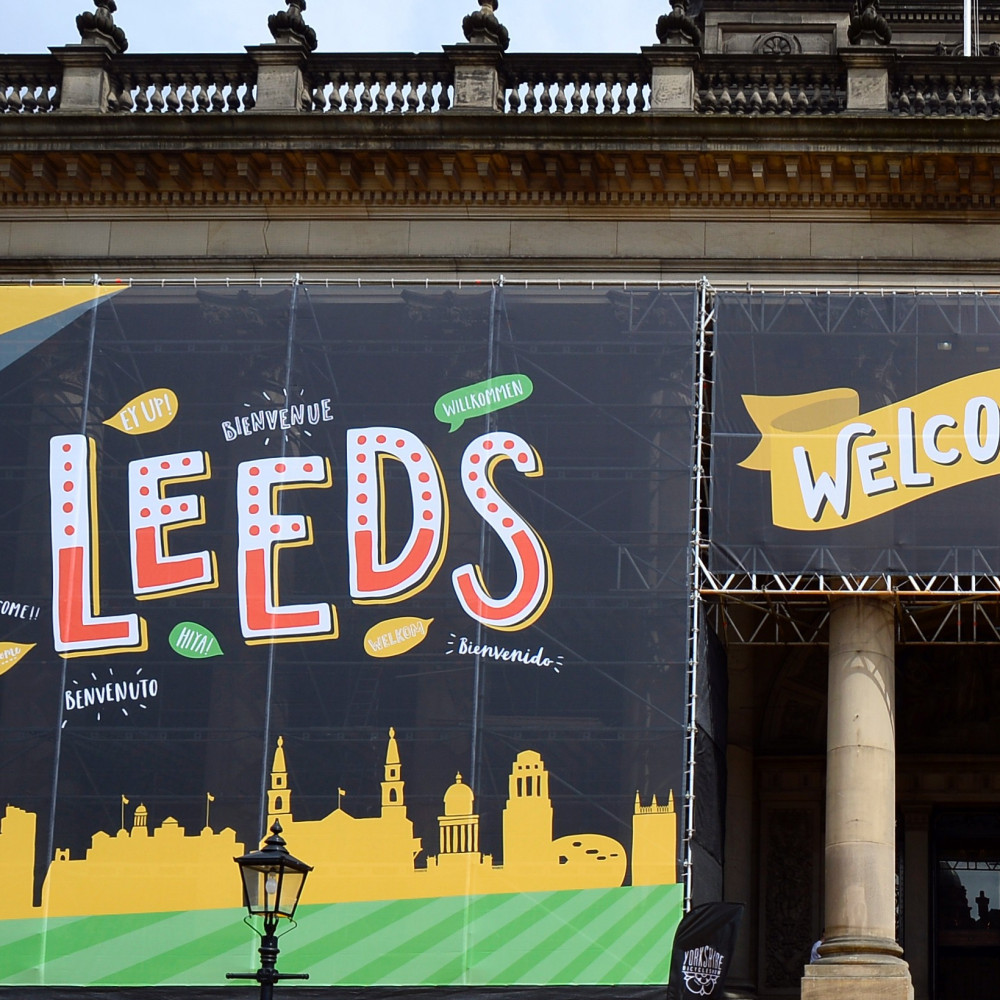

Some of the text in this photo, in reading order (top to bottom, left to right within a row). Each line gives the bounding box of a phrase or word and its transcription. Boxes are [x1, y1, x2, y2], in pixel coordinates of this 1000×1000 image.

[119, 393, 172, 431] EY UP!
[442, 380, 524, 417] WILLKOMMEN
[221, 398, 334, 442] BIENVENUE
[50, 427, 553, 661] LEEDS
[0, 600, 40, 620] OME!!
[176, 626, 214, 656] HIYA!
[367, 620, 425, 652] WELKOM
[458, 637, 554, 667] Bienvenido
[65, 679, 158, 711] BENVENUTO
[683, 945, 724, 971] YORKSHIRE
